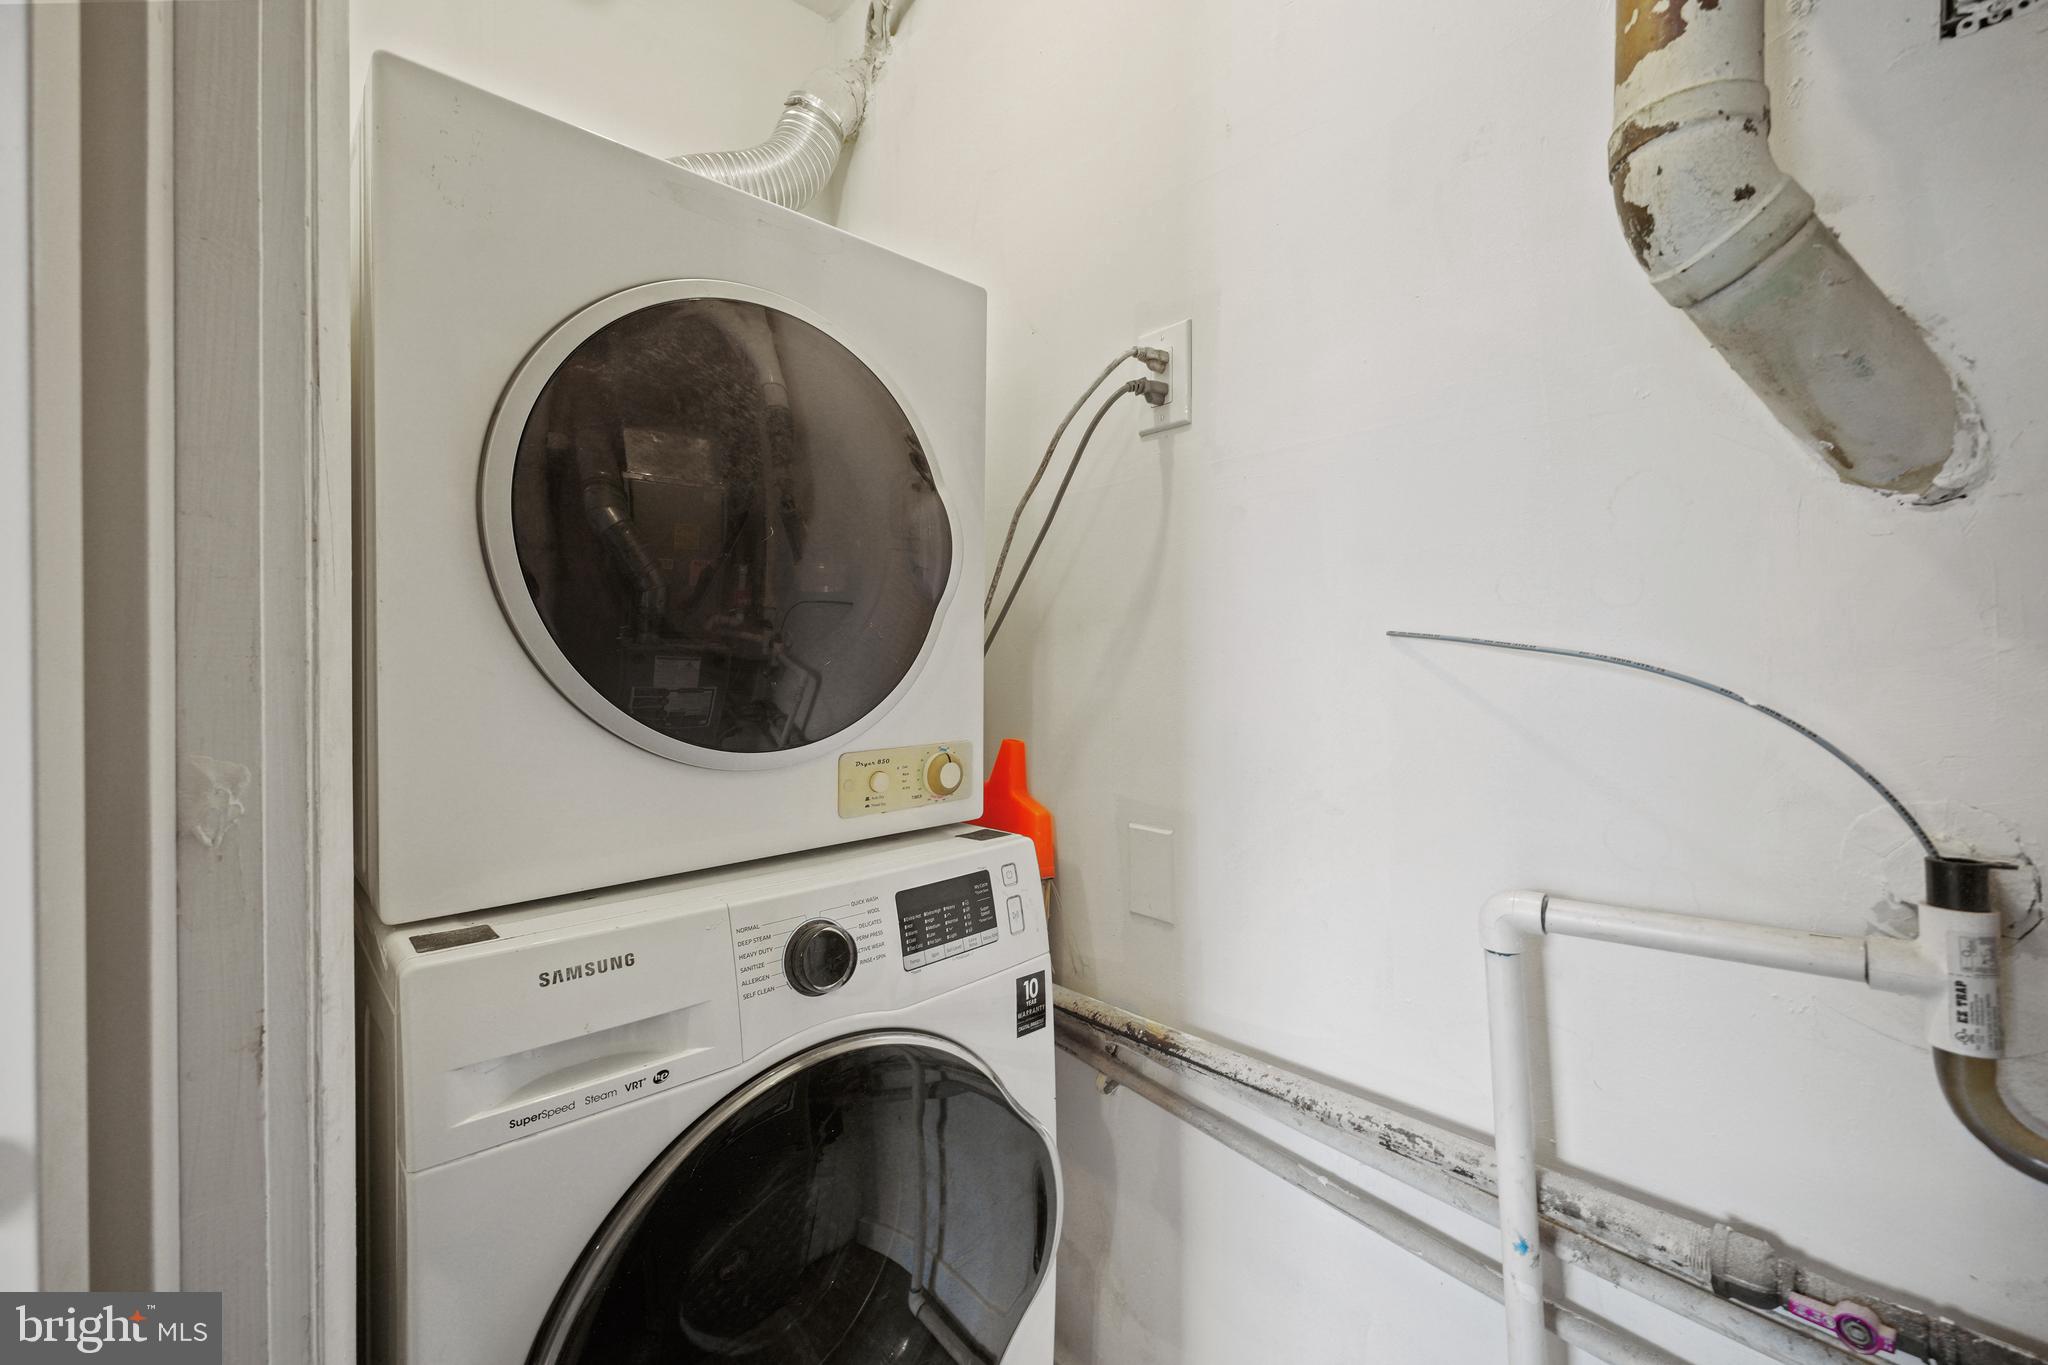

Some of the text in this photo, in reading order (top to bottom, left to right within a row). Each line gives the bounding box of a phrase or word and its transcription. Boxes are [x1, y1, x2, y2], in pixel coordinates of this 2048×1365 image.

[735, 924, 760, 935] NORMAL
[858, 918, 882, 929] DELICATES
[737, 933, 772, 948] DEEP STEAM
[738, 946, 774, 961] HEAVY DUTY
[538, 952, 636, 988] SAMSUNG
[739, 961, 765, 974] SANITIZE
[741, 973, 770, 987] ALLERGEN
[742, 985, 775, 1001] SELF CLEAN
[1023, 977, 1039, 1001] 10
[1954, 980, 1968, 1007] TRAP
[1026, 998, 1037, 1007] YEAR
[1017, 1003, 1045, 1020] WARRANTY
[509, 1100, 576, 1129] SuperSpeed
[584, 1088, 618, 1106] Steam
